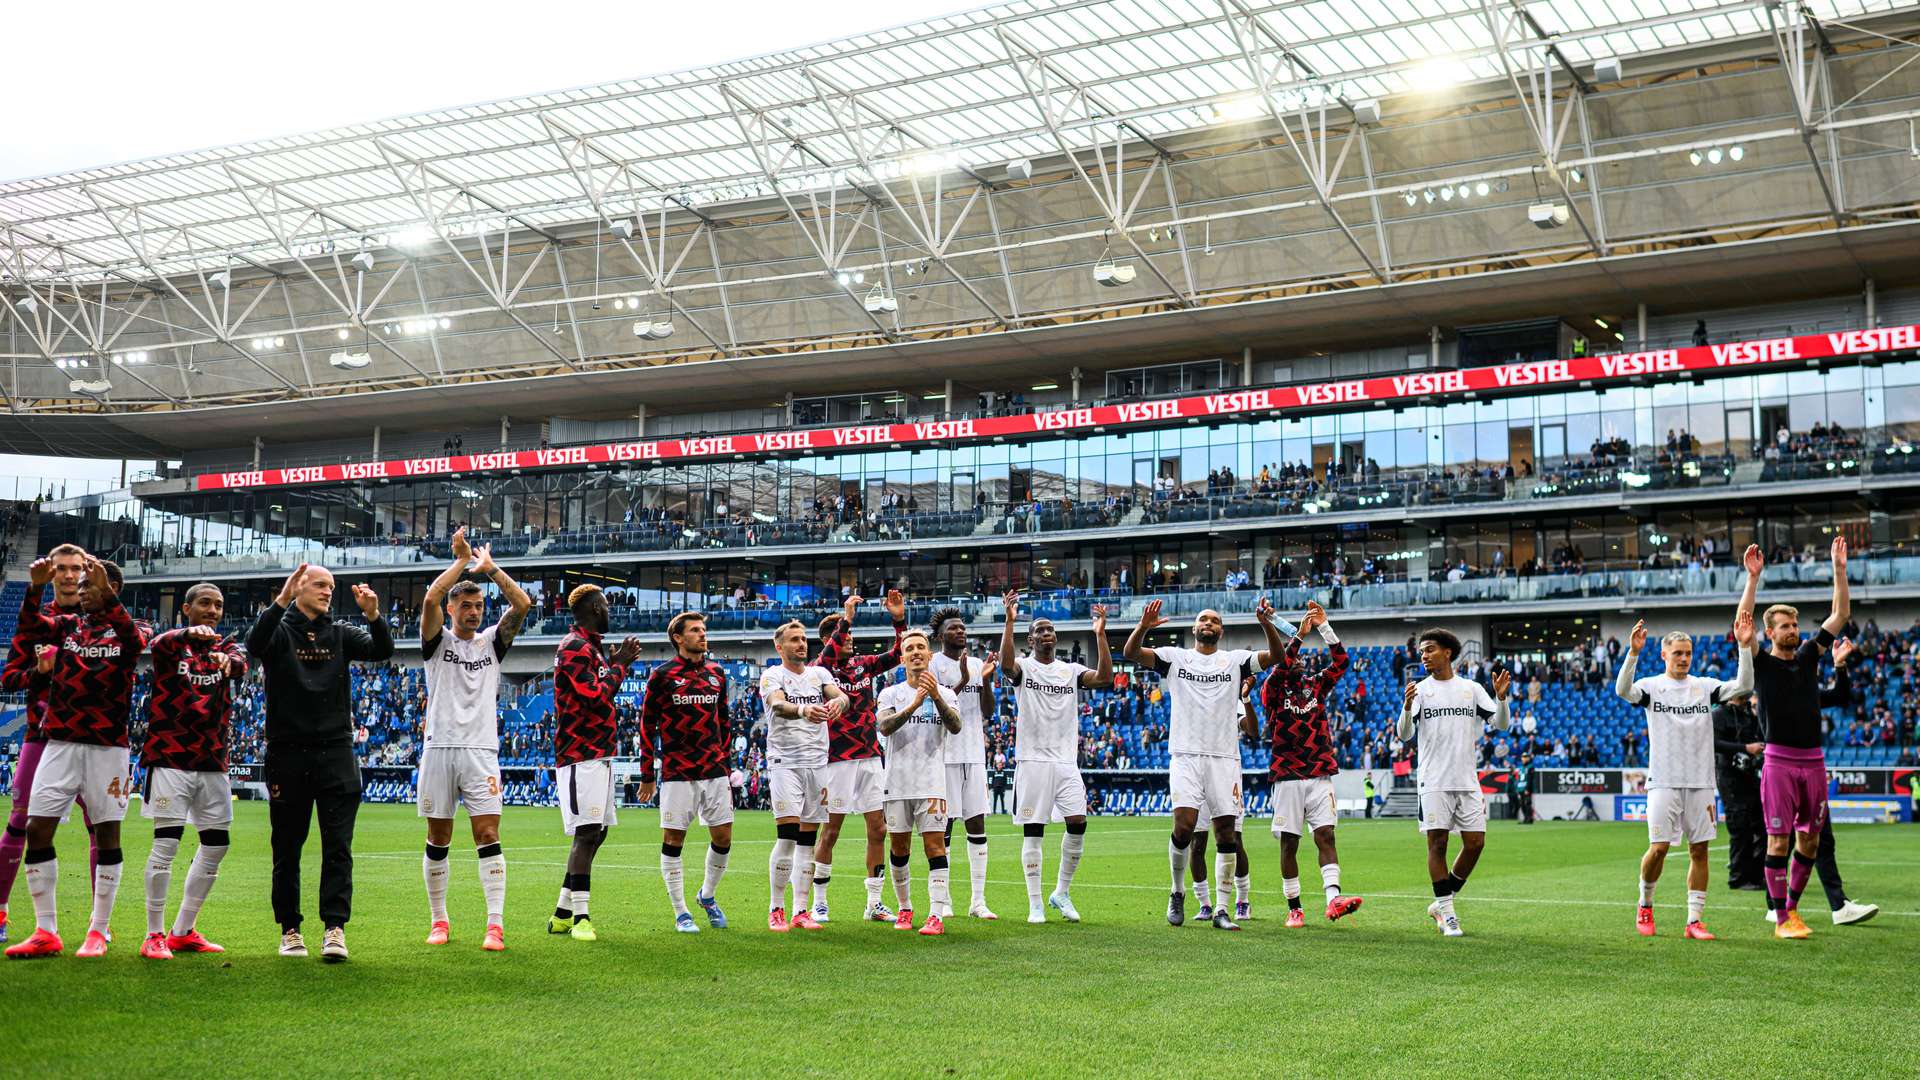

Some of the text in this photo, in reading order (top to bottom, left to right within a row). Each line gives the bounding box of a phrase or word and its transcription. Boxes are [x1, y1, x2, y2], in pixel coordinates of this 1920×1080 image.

[222, 325, 1920, 487] VESTEL VESTEL VESTEL VESTEL VESTEL VESTEL VESTEL VESTEL VESTEL VESTEL VESTEL VESTEL VESTEL VESTEL VESTEL VESTEL VESTEL VESTEL VESTEL VESTEL
[1177, 668, 1232, 683] Barmenia
[672, 692, 720, 705] Barmeni
[1423, 704, 1474, 720] Barmenia
[1557, 771, 1606, 785] schaa
[1826, 770, 1866, 784] haa
[487, 775, 502, 796] 3
